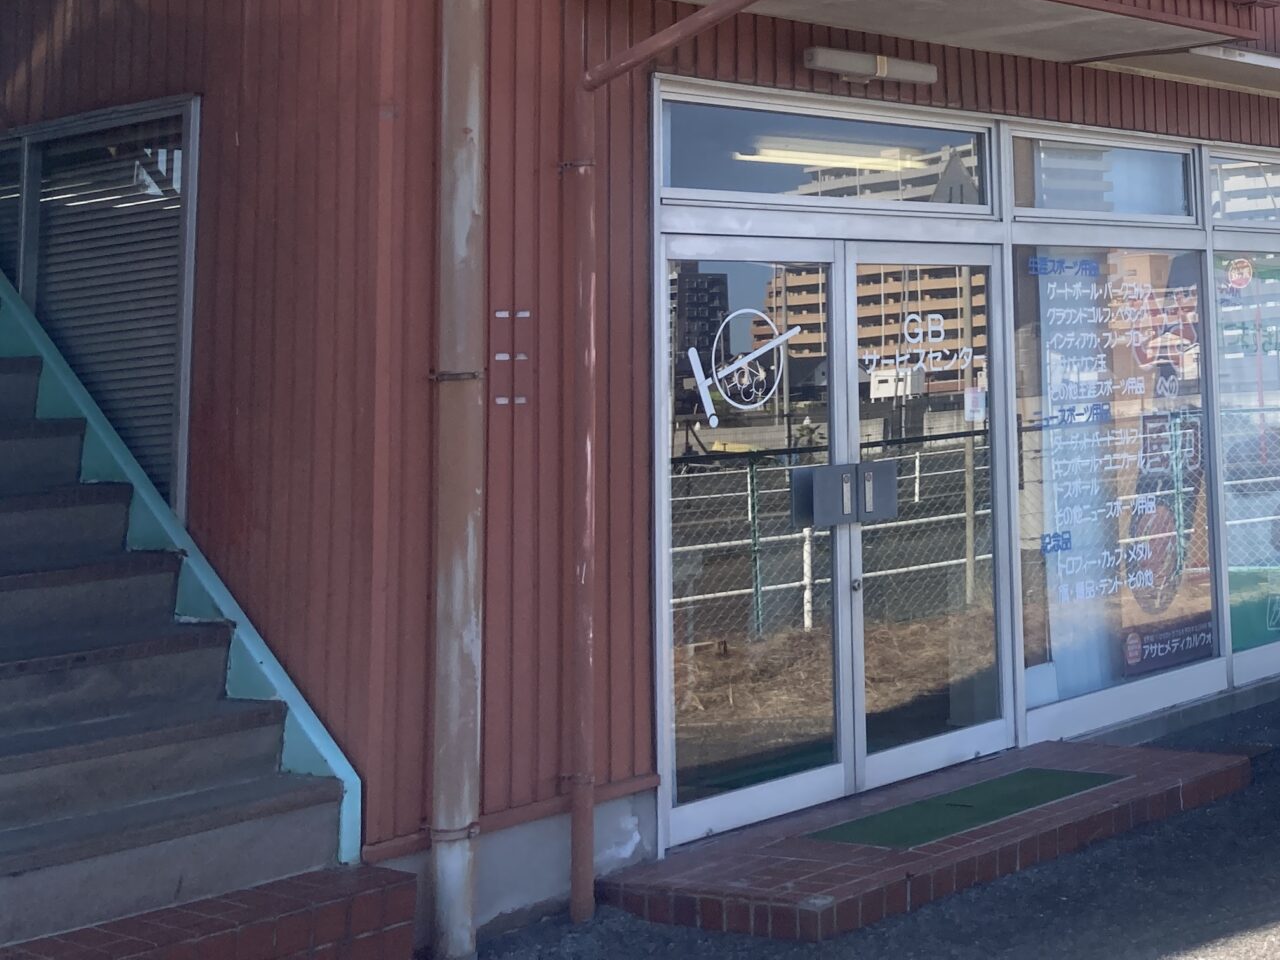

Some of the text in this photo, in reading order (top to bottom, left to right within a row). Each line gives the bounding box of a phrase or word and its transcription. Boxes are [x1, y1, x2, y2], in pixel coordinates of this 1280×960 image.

[904, 313, 944, 344] GB
[863, 346, 986, 374] サービスセンター
[1041, 531, 1072, 554] 記念品
